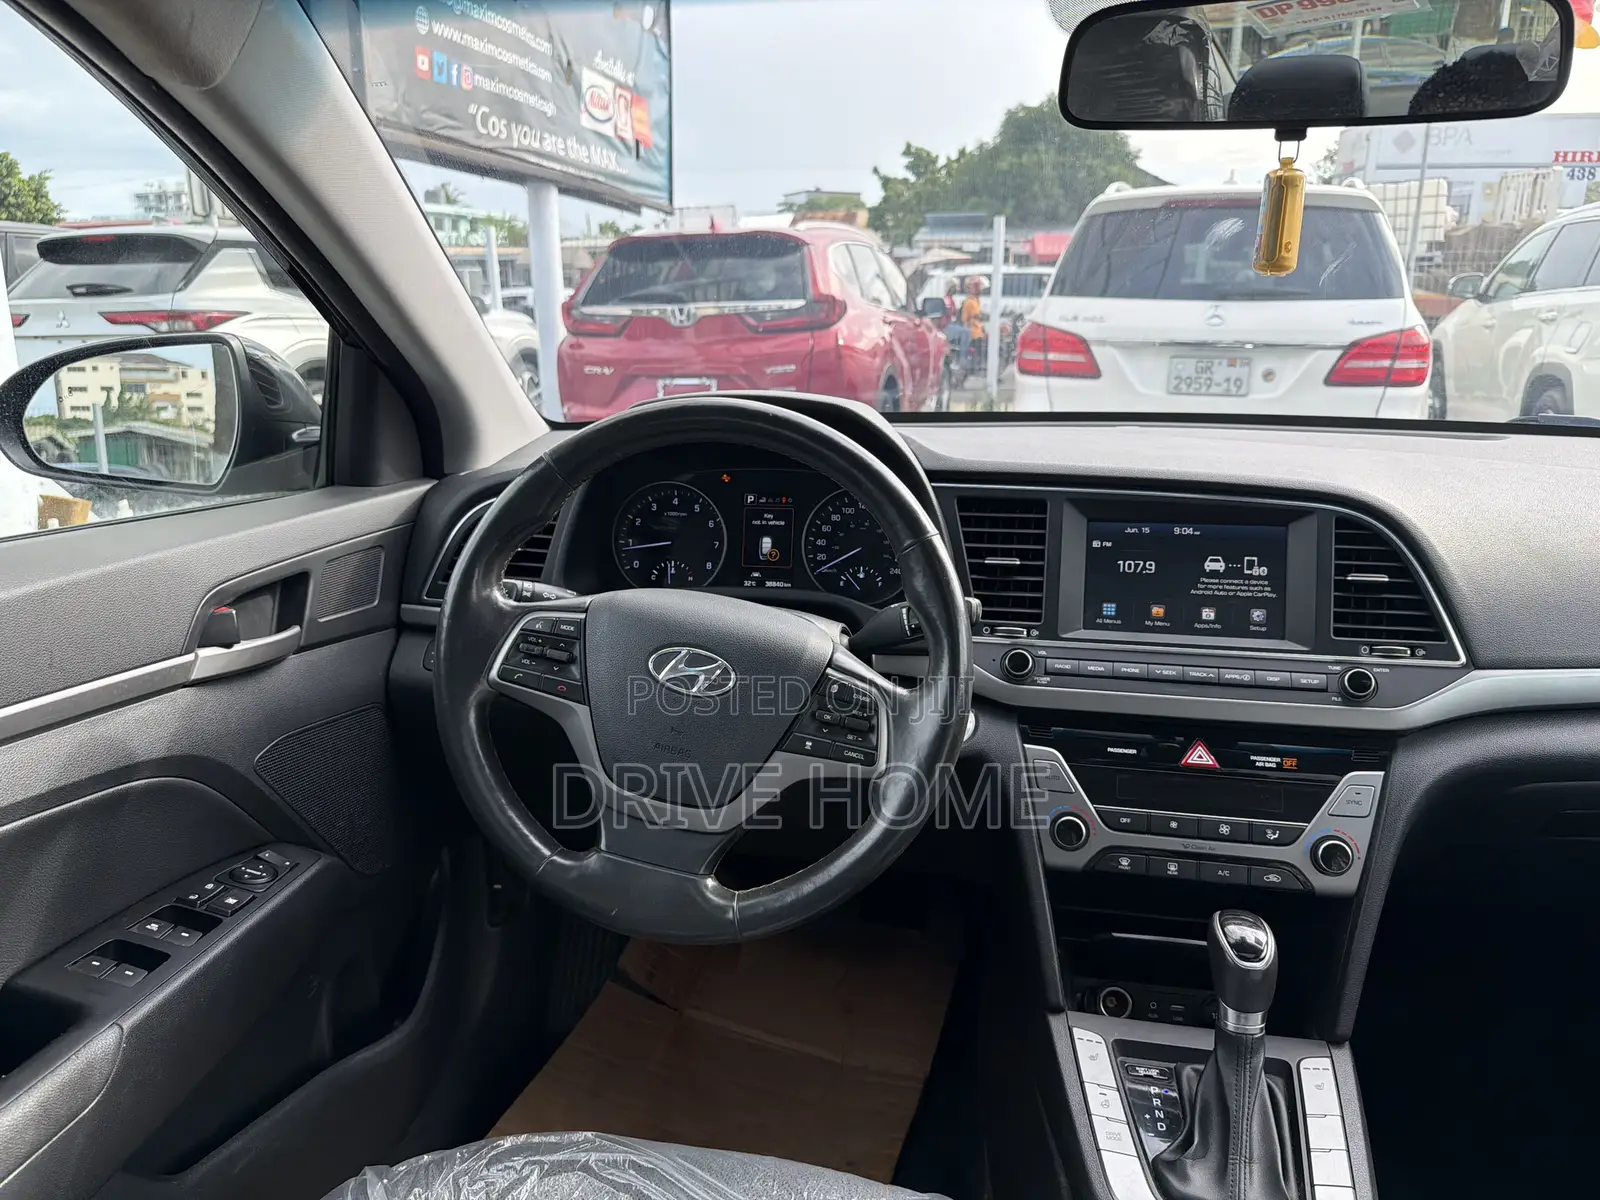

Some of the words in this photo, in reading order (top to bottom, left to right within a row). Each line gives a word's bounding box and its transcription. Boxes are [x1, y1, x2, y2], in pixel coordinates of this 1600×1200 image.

[510, 121, 541, 149] you
[543, 132, 567, 157] are
[567, 134, 590, 164] the
[1566, 167, 1597, 182] 438
[1195, 360, 1215, 376] GR
[1172, 376, 1244, 395] 2959-19
[672, 497, 680, 506] 4
[747, 495, 755, 504] P
[651, 503, 657, 512] 3
[694, 504, 701, 512] 5
[841, 507, 855, 515] 100
[763, 512, 775, 521] Key
[831, 514, 841, 522] 80
[635, 518, 642, 526] 2
[708, 520, 715, 528] 6
[1124, 526, 1139, 534] Jun.
[1141, 526, 1151, 534] 15
[1173, 526, 1194, 536] 9:04
[714, 541, 720, 550] 7
[816, 553, 827, 561] 20
[633, 560, 640, 569] 0
[706, 562, 713, 571] 8
[1116, 560, 1156, 574] 107.9
[651, 574, 657, 582] C
[1250, 578, 1269, 586] device
[1190, 588, 1214, 596] Android
[1236, 590, 1253, 598] Apple
[1144, 619, 1154, 627] My
[1193, 622, 1222, 631] Apps/Info
[560, 624, 575, 632] MODE
[1249, 625, 1268, 633] Setup
[823, 713, 832, 721] OK
[846, 733, 857, 741] SET
[843, 749, 865, 760] CANCEL
[1107, 746, 1138, 755] PASSENGER
[1250, 755, 1281, 763] PASSENGER
[1283, 760, 1298, 769] OFF
[1254, 760, 1266, 768] AIR
[1119, 816, 1132, 824] OFF
[1217, 868, 1231, 877] A/C
[1150, 1086, 1159, 1095] P
[1152, 1098, 1162, 1107] R
[1154, 1109, 1165, 1119] N
[1157, 1121, 1167, 1131] D
